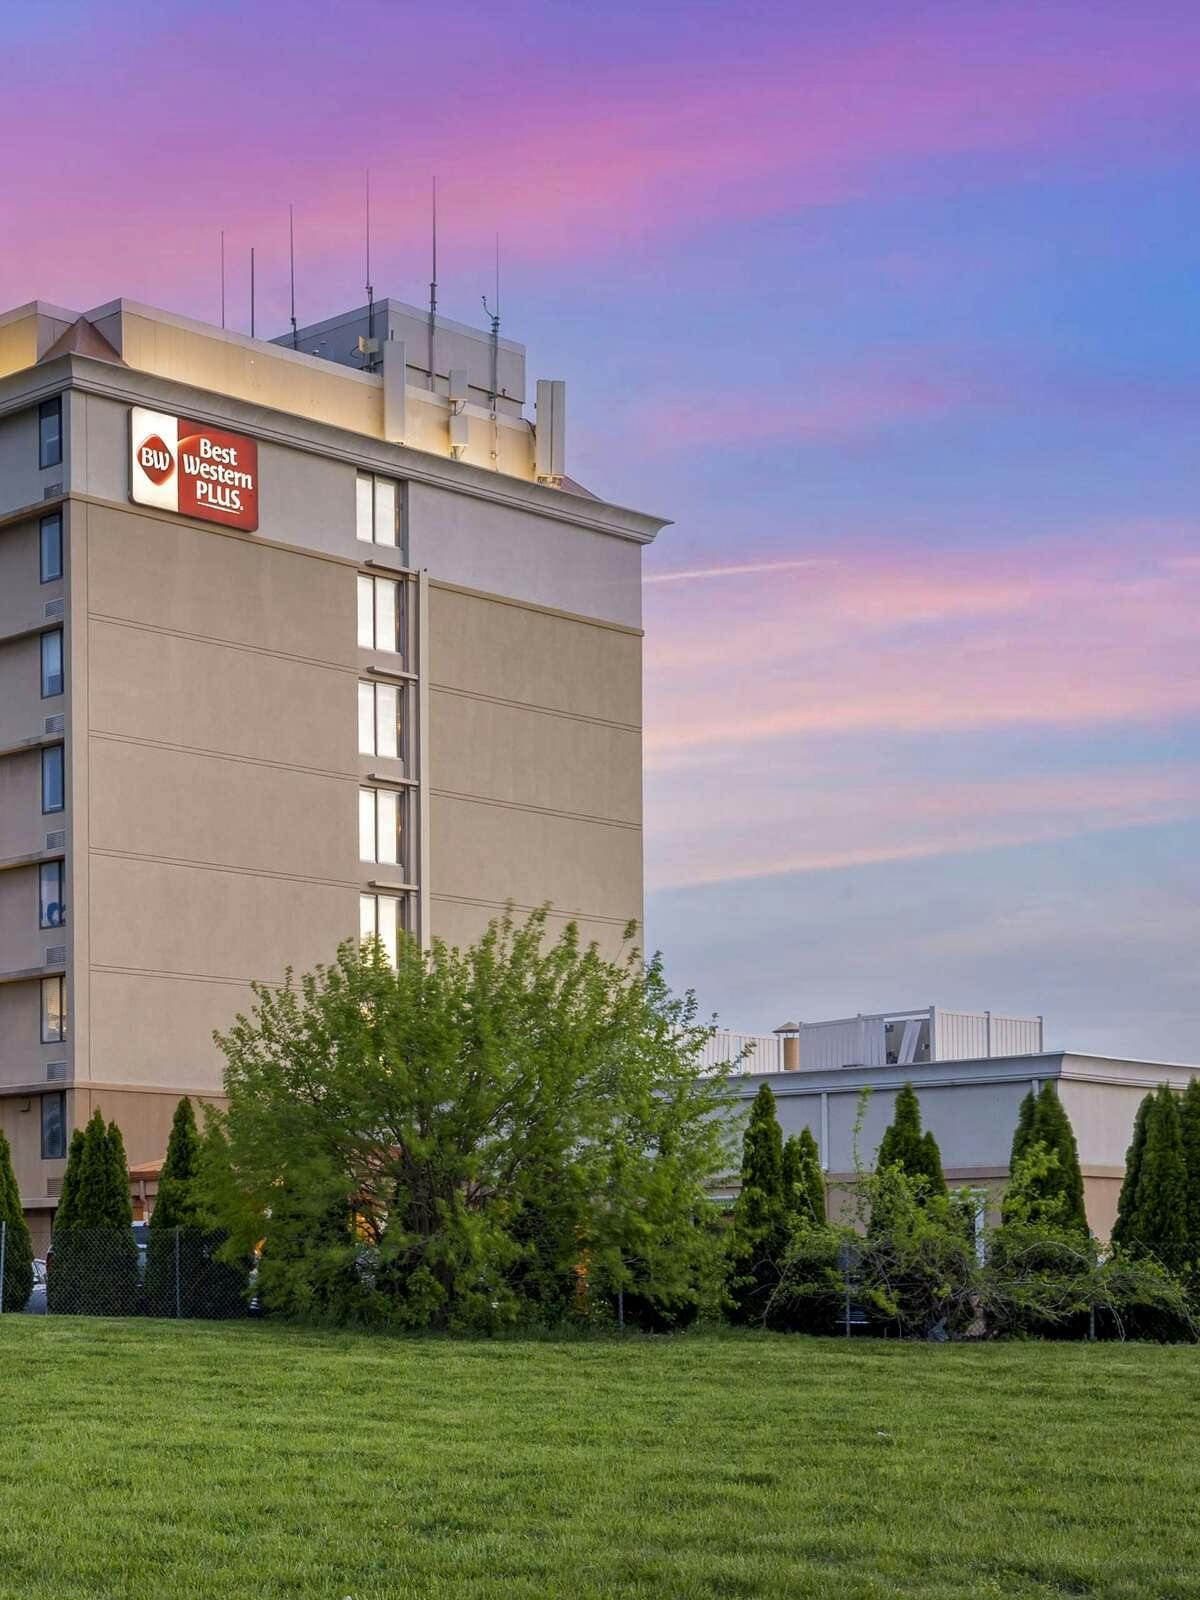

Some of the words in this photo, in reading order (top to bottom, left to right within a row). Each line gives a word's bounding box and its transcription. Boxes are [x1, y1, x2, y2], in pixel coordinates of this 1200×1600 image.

[141, 447, 170, 471] BW
[200, 438, 238, 466] Best
[183, 453, 253, 490] Western
